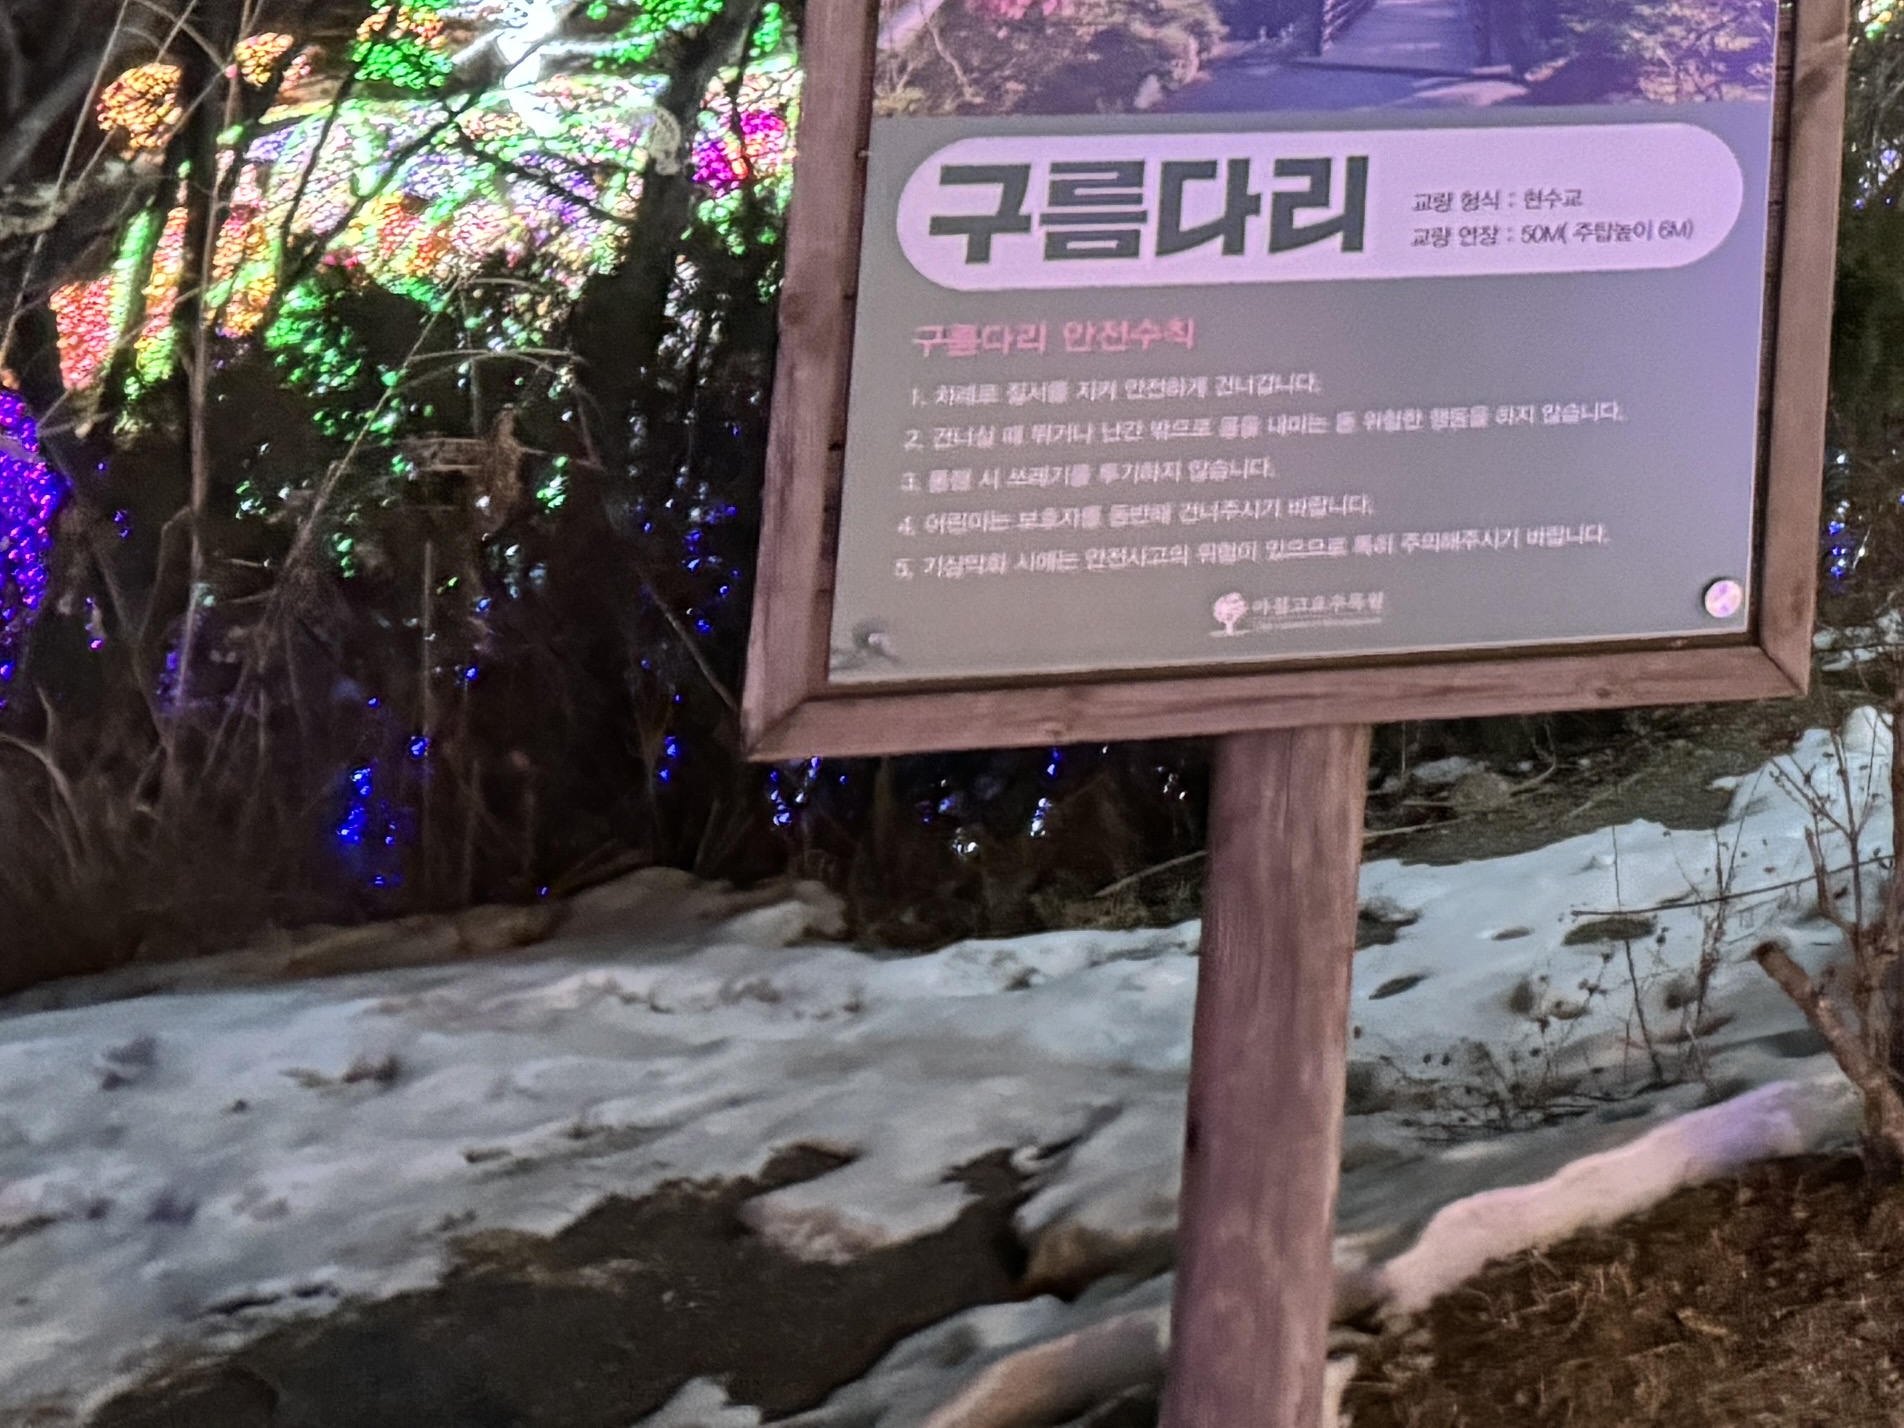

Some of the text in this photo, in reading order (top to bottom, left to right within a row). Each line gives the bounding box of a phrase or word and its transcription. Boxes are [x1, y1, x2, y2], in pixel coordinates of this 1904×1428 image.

[929, 155, 1369, 265] 구름다리
[1411, 191, 1453, 213] 교량
[1461, 189, 1500, 211] 형식
[1523, 187, 1584, 211] 현수교
[1410, 225, 1451, 249] 교량
[1458, 224, 1499, 247] 연장
[1572, 220, 1652, 244] 주탑높이
[913, 317, 1197, 358] 구름다리 안전수칙
